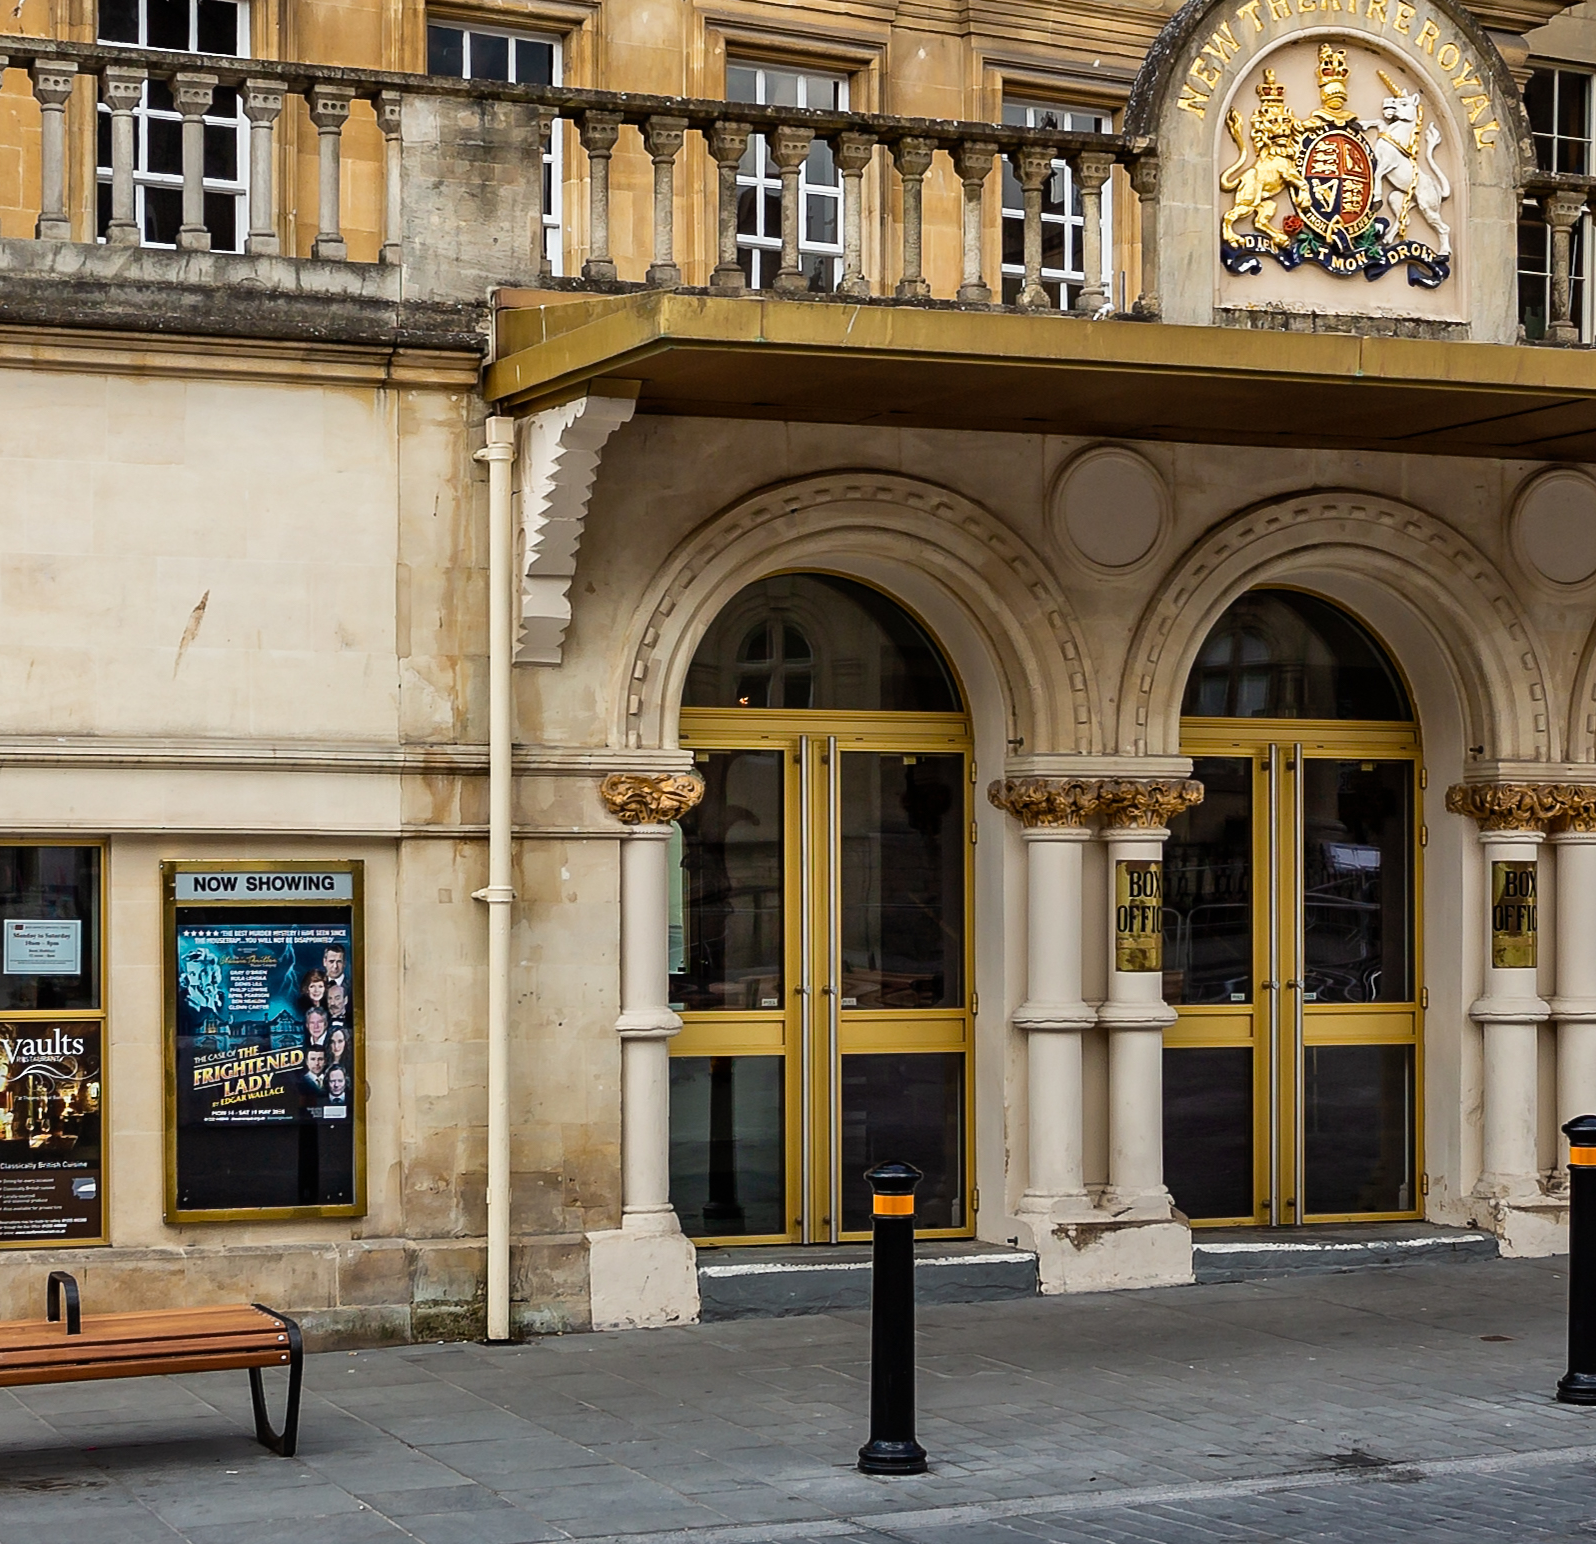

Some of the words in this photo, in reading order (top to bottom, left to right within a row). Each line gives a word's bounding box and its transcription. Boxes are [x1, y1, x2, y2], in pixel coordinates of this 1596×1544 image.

[1177, 21, 1241, 119] NEW
[1415, 17, 1499, 150] ROYAL
[1304, 247, 1329, 260] ET
[1332, 251, 1369, 270] MON
[1388, 244, 1437, 264] DROIT
[193, 877, 238, 892] NOW
[246, 876, 334, 891] SHOWING
[1130, 870, 1161, 898] BOX
[1505, 871, 1537, 897] BOX
[1117, 905, 1161, 933] OFFIC
[1493, 905, 1537, 932] OFFIC
[193, 1055, 207, 1064] THE
[208, 1053, 226, 1062] CASE
[227, 1050, 236, 1058] OF
[238, 1045, 259, 1058] THE
[193, 1050, 304, 1086] FRIGHTENED
[221, 1095, 246, 1106] EDGAR
[248, 1086, 285, 1099] WALLACE
[224, 1073, 274, 1097] LADY
[0, 1162, 36, 1170] Classically
